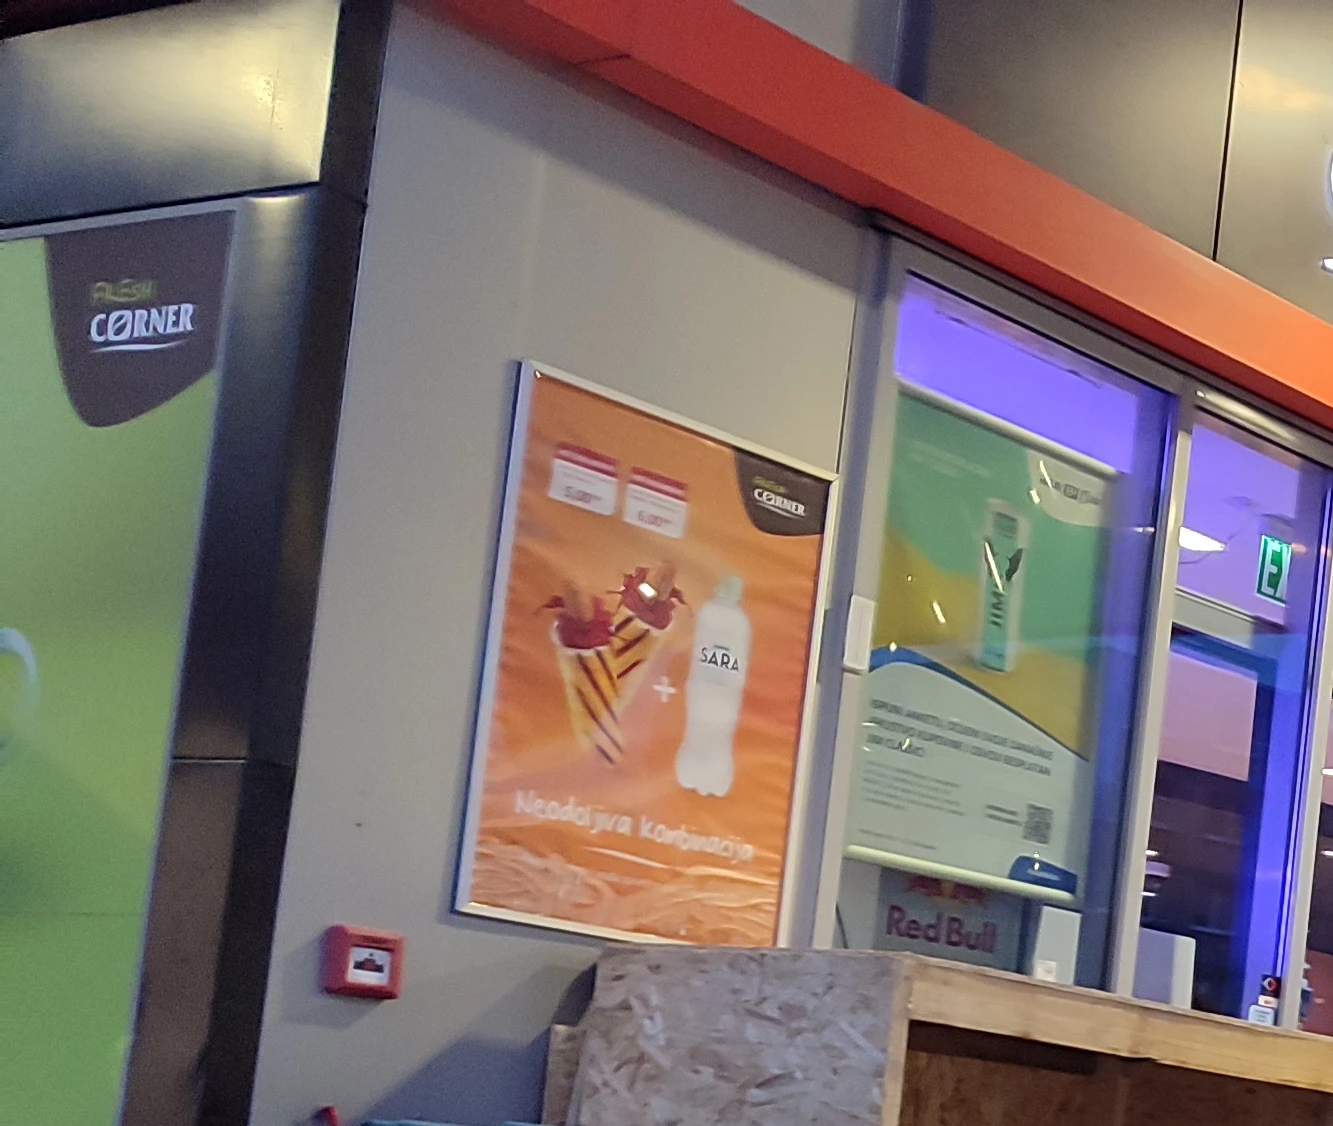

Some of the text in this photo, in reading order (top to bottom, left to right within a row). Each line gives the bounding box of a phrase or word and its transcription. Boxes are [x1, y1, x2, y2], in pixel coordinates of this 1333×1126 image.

[90, 303, 194, 342] CORNER
[700, 647, 739, 671] SARA
[515, 790, 632, 836] Neodoljiva
[886, 904, 996, 954] Red Bull
